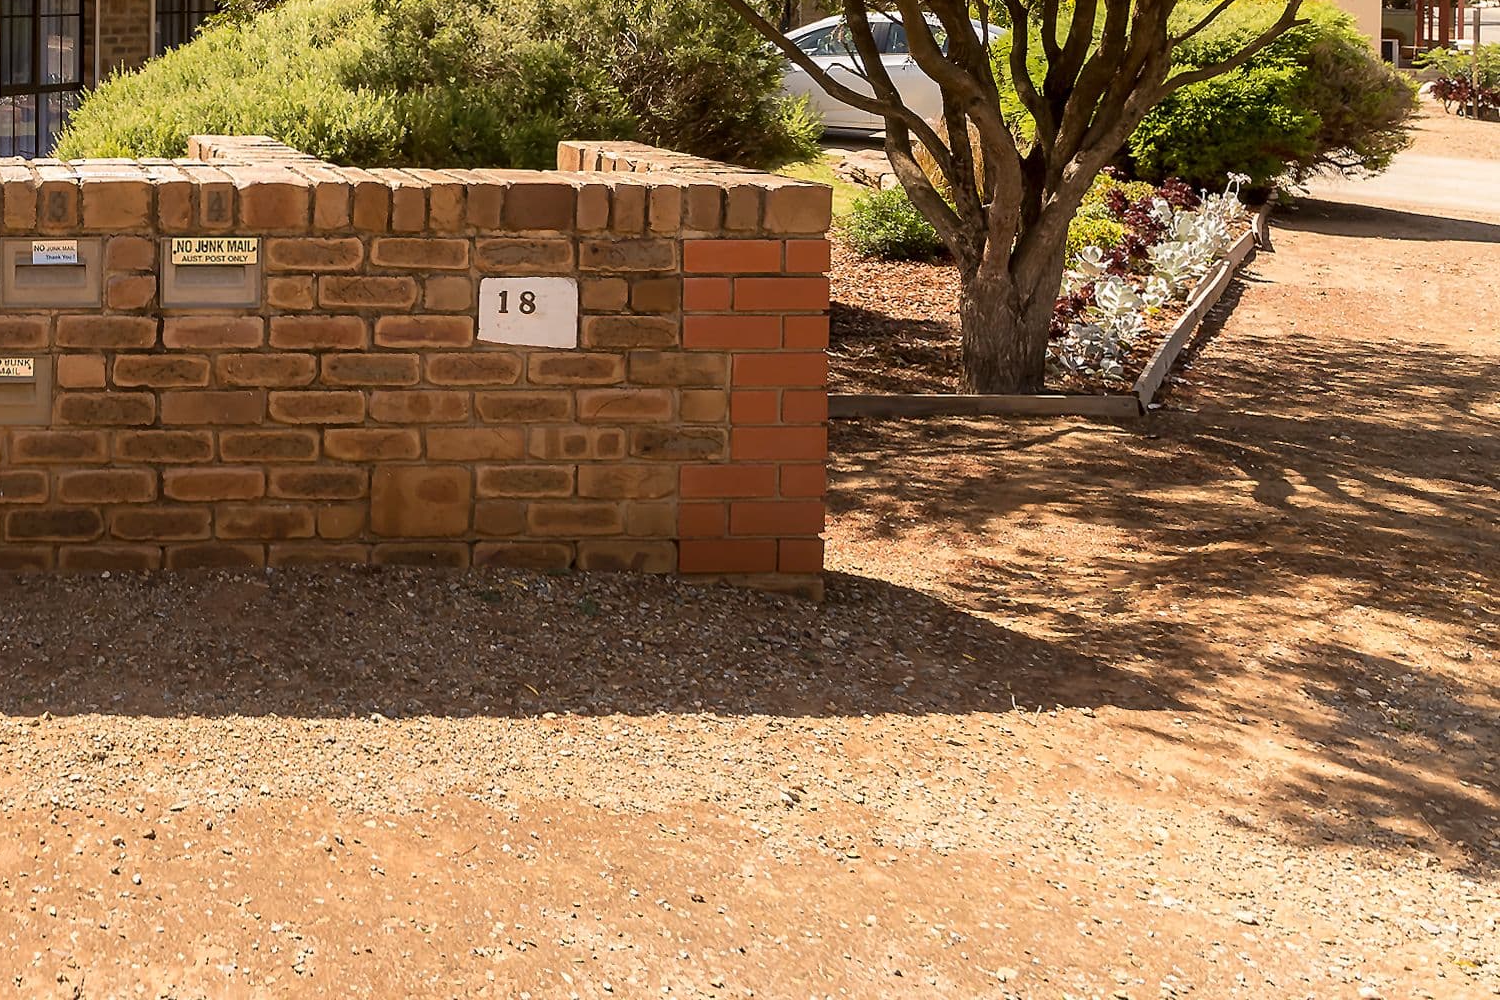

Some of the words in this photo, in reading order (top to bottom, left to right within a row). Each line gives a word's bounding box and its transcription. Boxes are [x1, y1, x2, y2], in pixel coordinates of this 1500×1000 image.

[177, 240, 192, 253] NO
[195, 240, 224, 253] JUNK
[227, 240, 252, 252] MAIL
[498, 290, 537, 315] 18
[4, 359, 31, 367] JUNK
